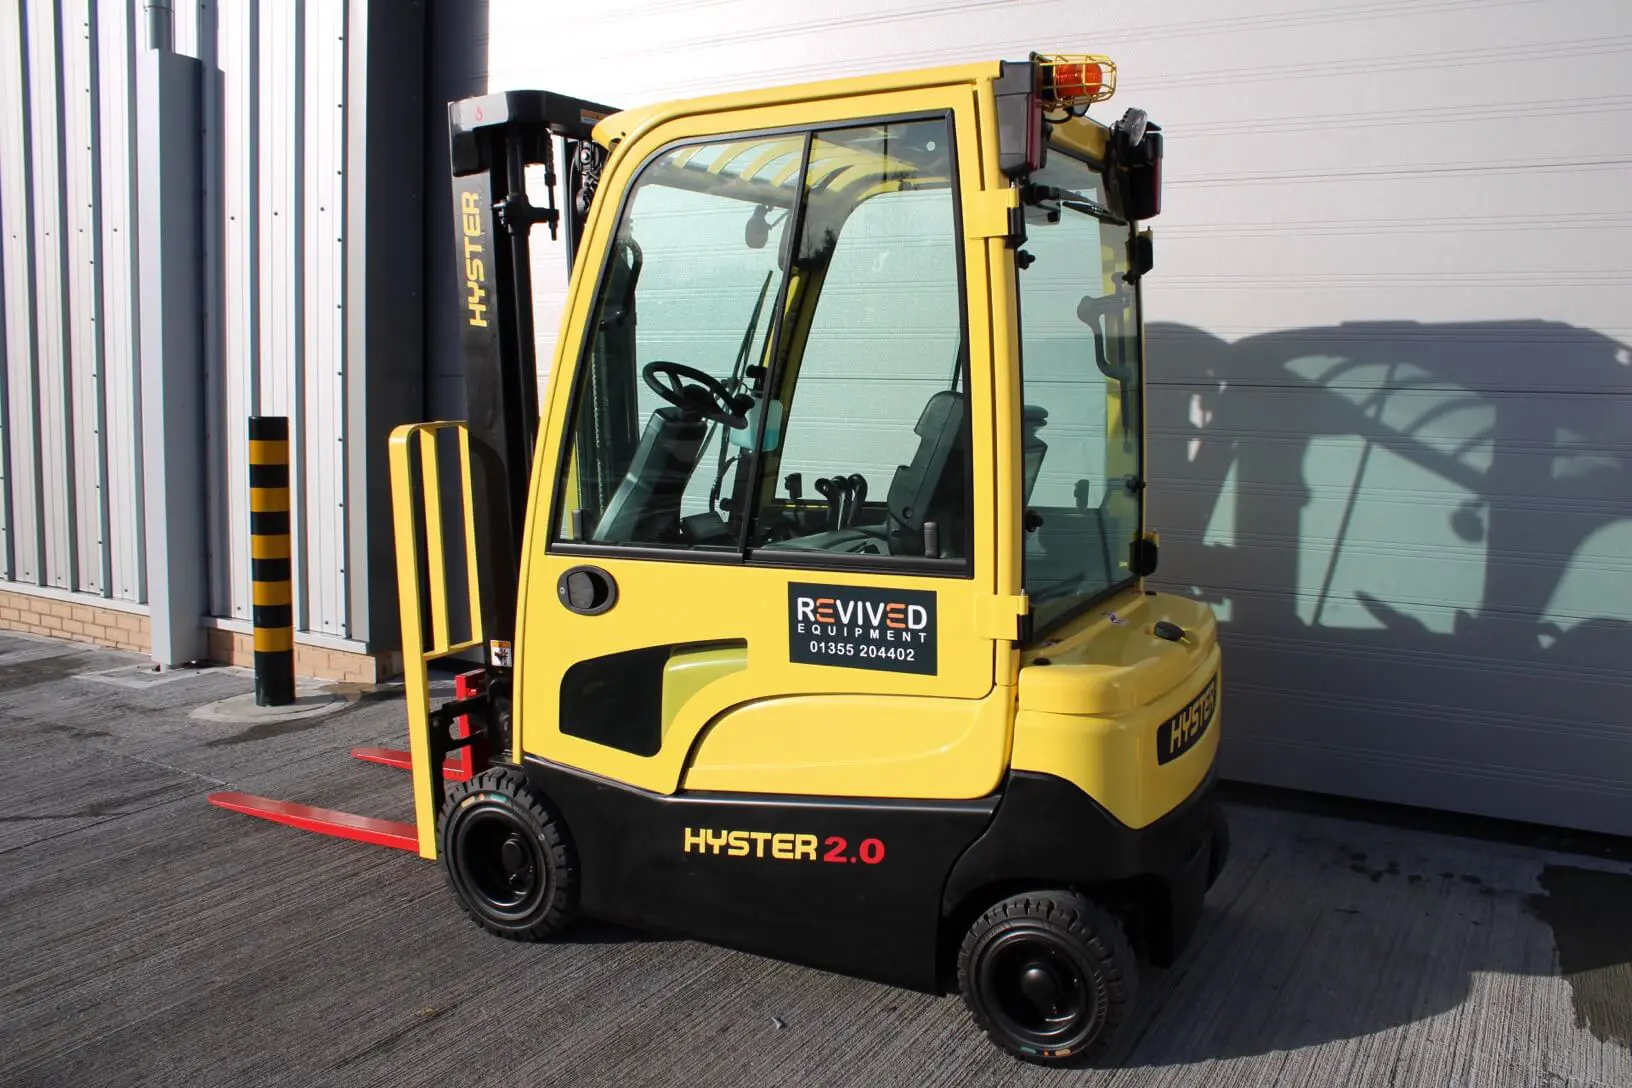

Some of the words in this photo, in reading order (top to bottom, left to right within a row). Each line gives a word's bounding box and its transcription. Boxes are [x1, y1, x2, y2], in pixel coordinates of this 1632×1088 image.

[461, 191, 488, 328] HYSTER
[797, 597, 928, 630] REVIVED
[798, 623, 927, 643] EQUIPMENT
[810, 640, 854, 656] 01355
[859, 645, 915, 661] 204402
[684, 827, 818, 860] HYSTER
[823, 836, 885, 864] 2.0
